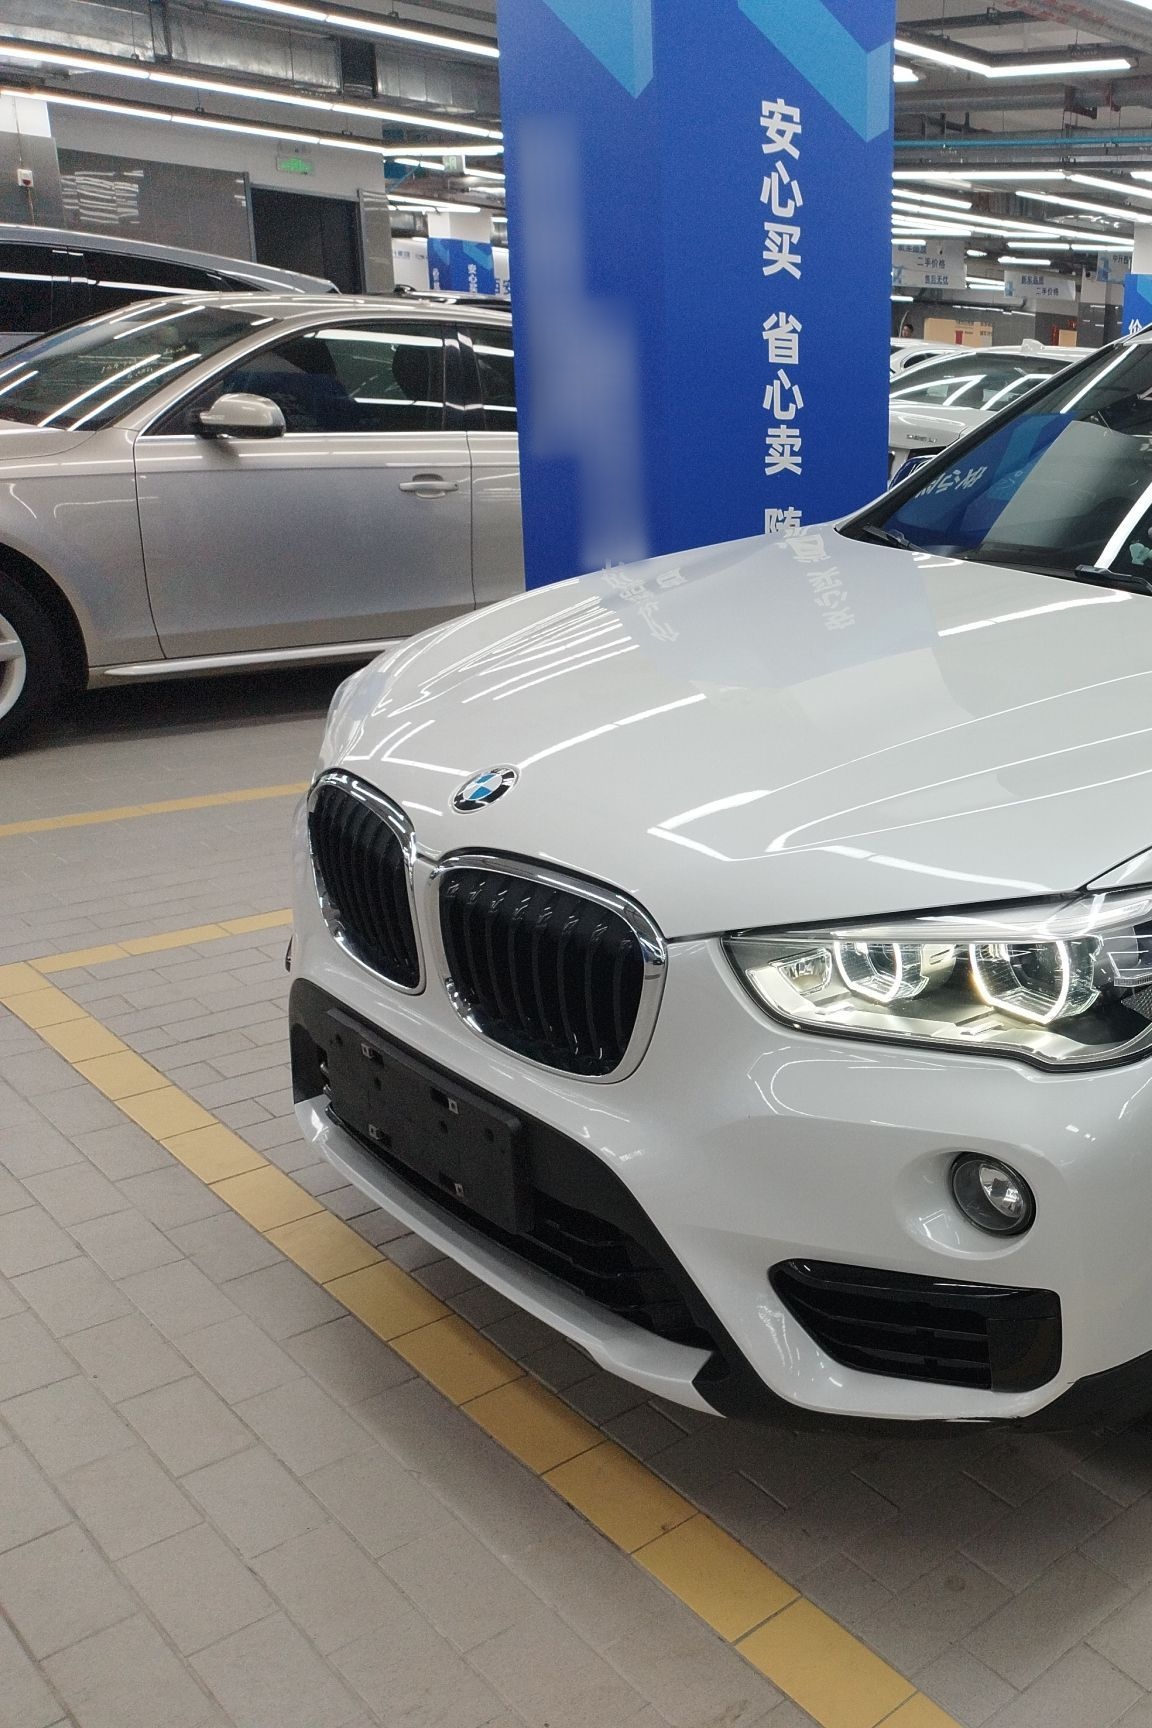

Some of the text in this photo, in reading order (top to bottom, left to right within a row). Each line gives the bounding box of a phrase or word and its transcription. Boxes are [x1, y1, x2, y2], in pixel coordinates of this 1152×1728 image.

[760, 98, 803, 279] 安心买
[917, 257, 946, 269] 二手价格
[762, 312, 804, 475] 省心卖
